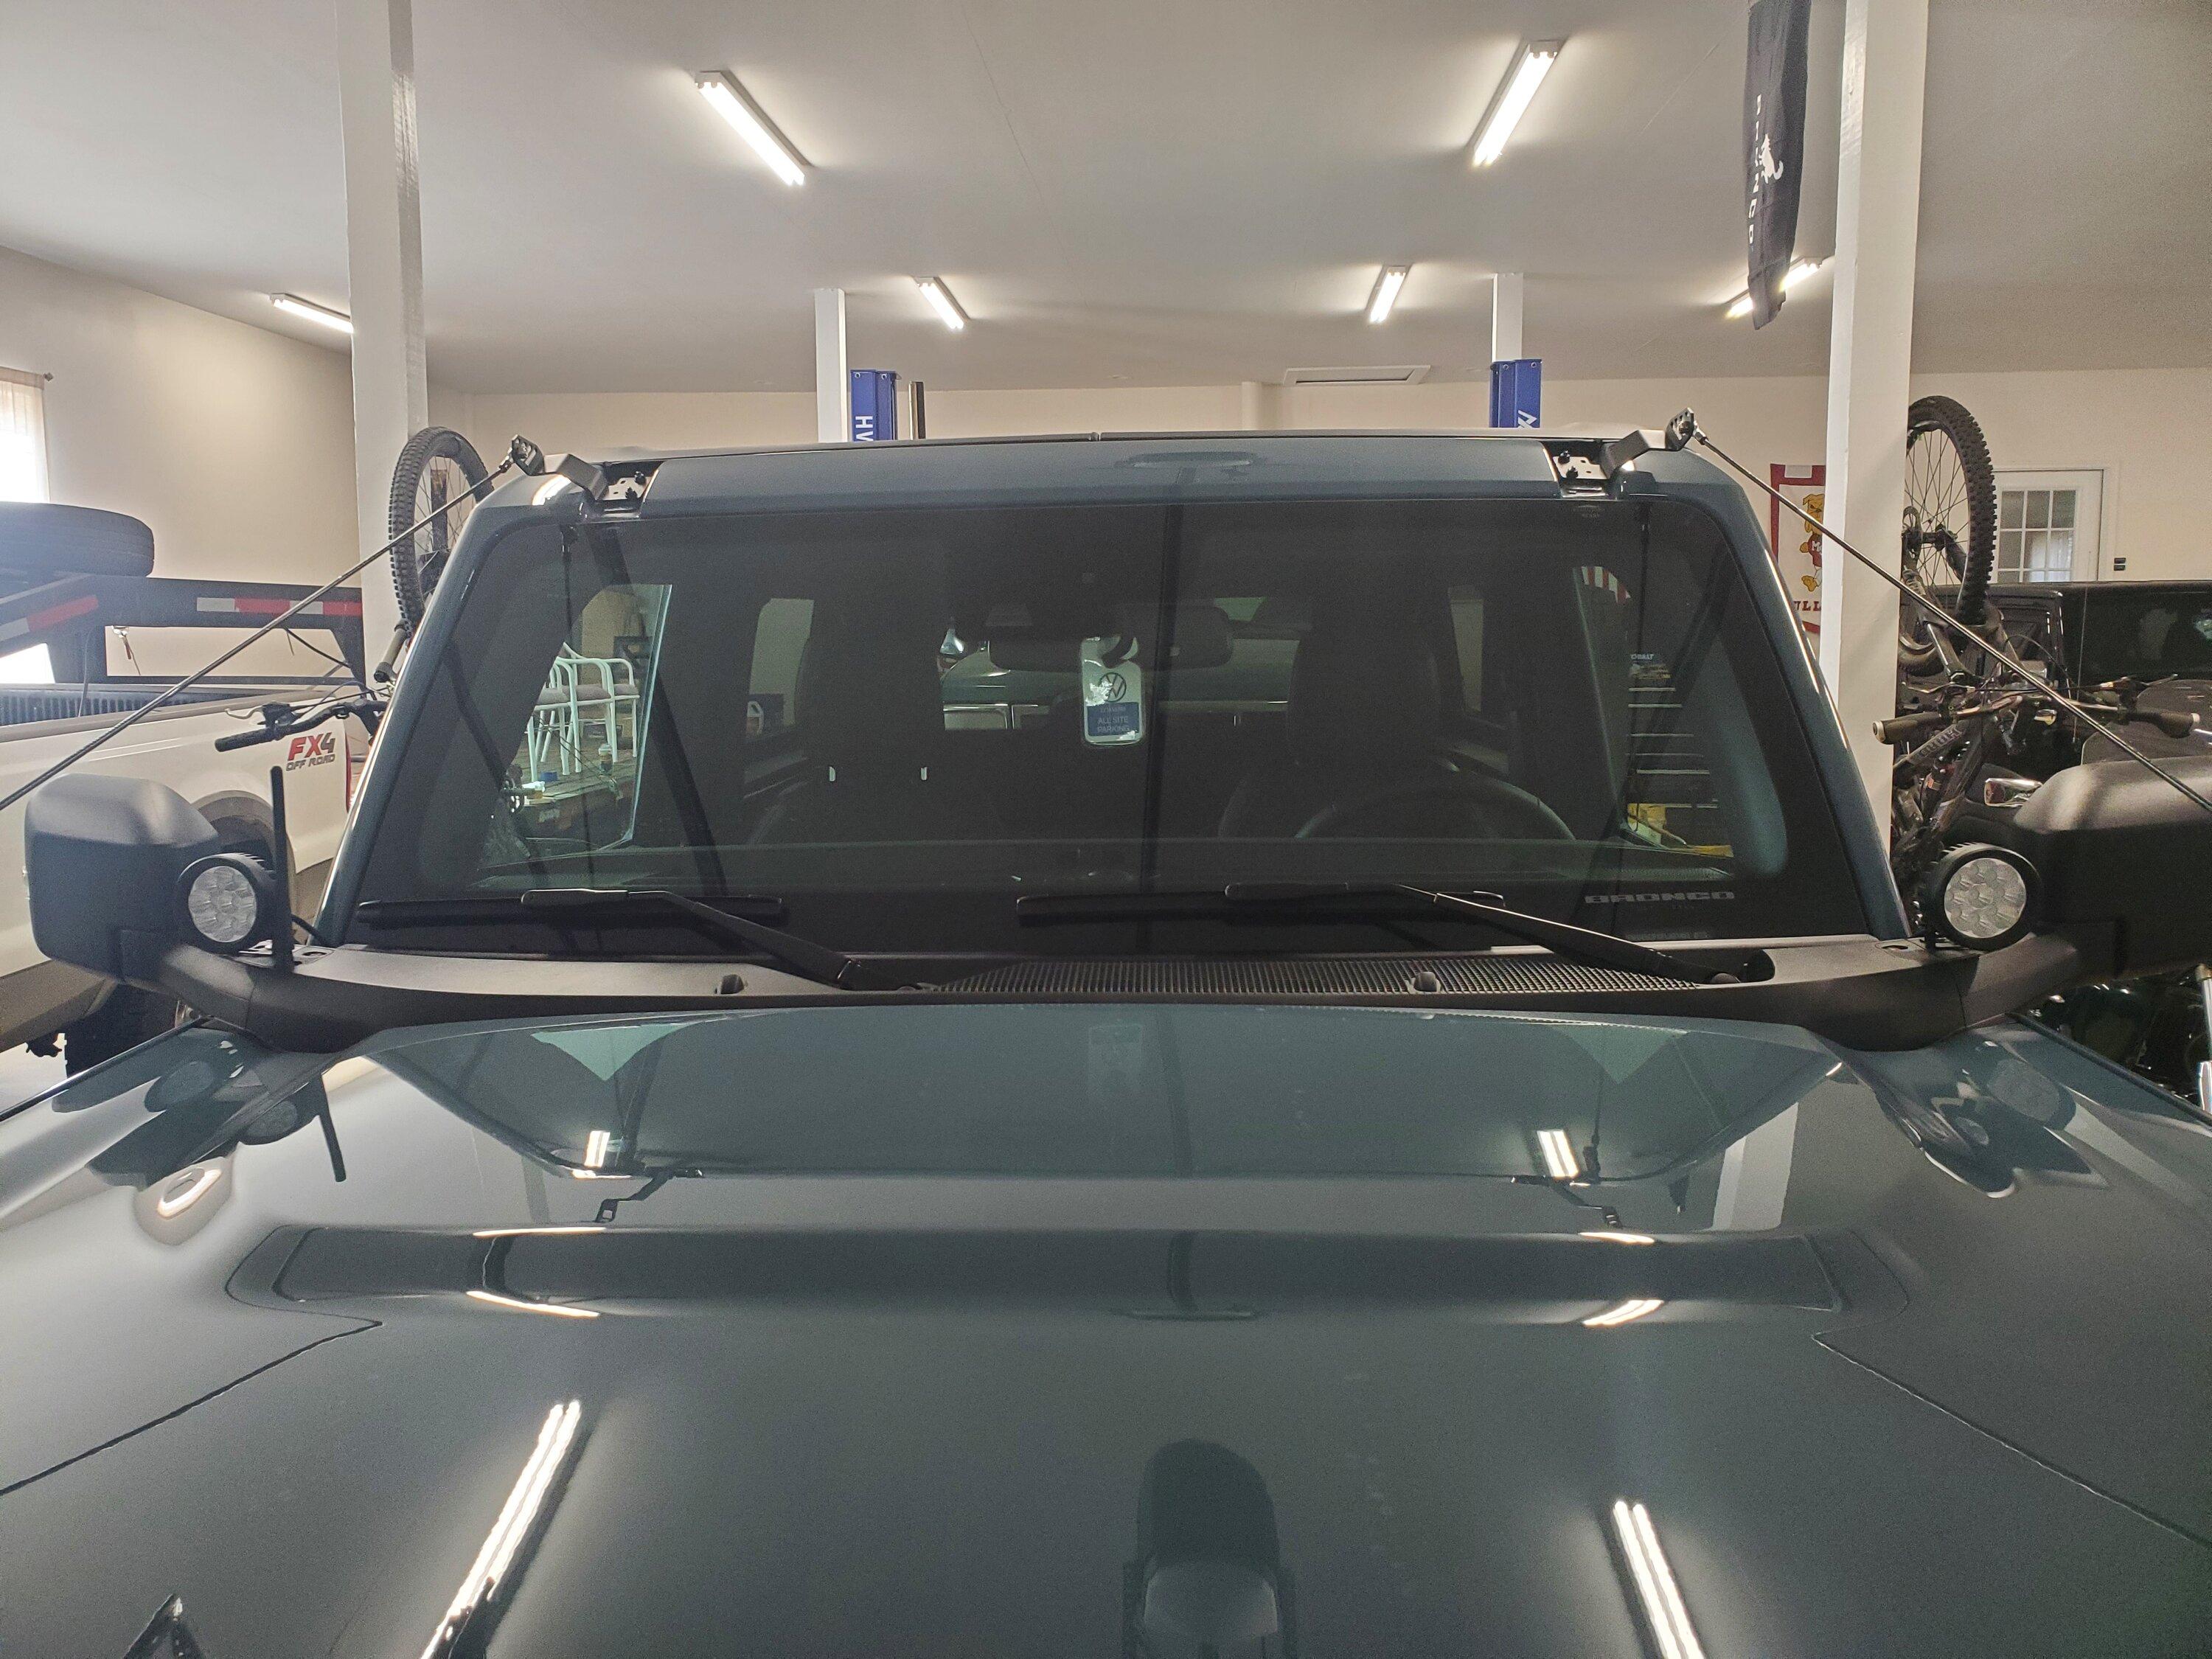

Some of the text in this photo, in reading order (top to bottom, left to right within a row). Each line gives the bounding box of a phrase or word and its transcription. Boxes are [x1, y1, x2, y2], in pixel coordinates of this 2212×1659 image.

[288, 732, 336, 761] FX4
[286, 754, 336, 771] OFF ROAD
[1585, 891, 1735, 904] BRONCO
